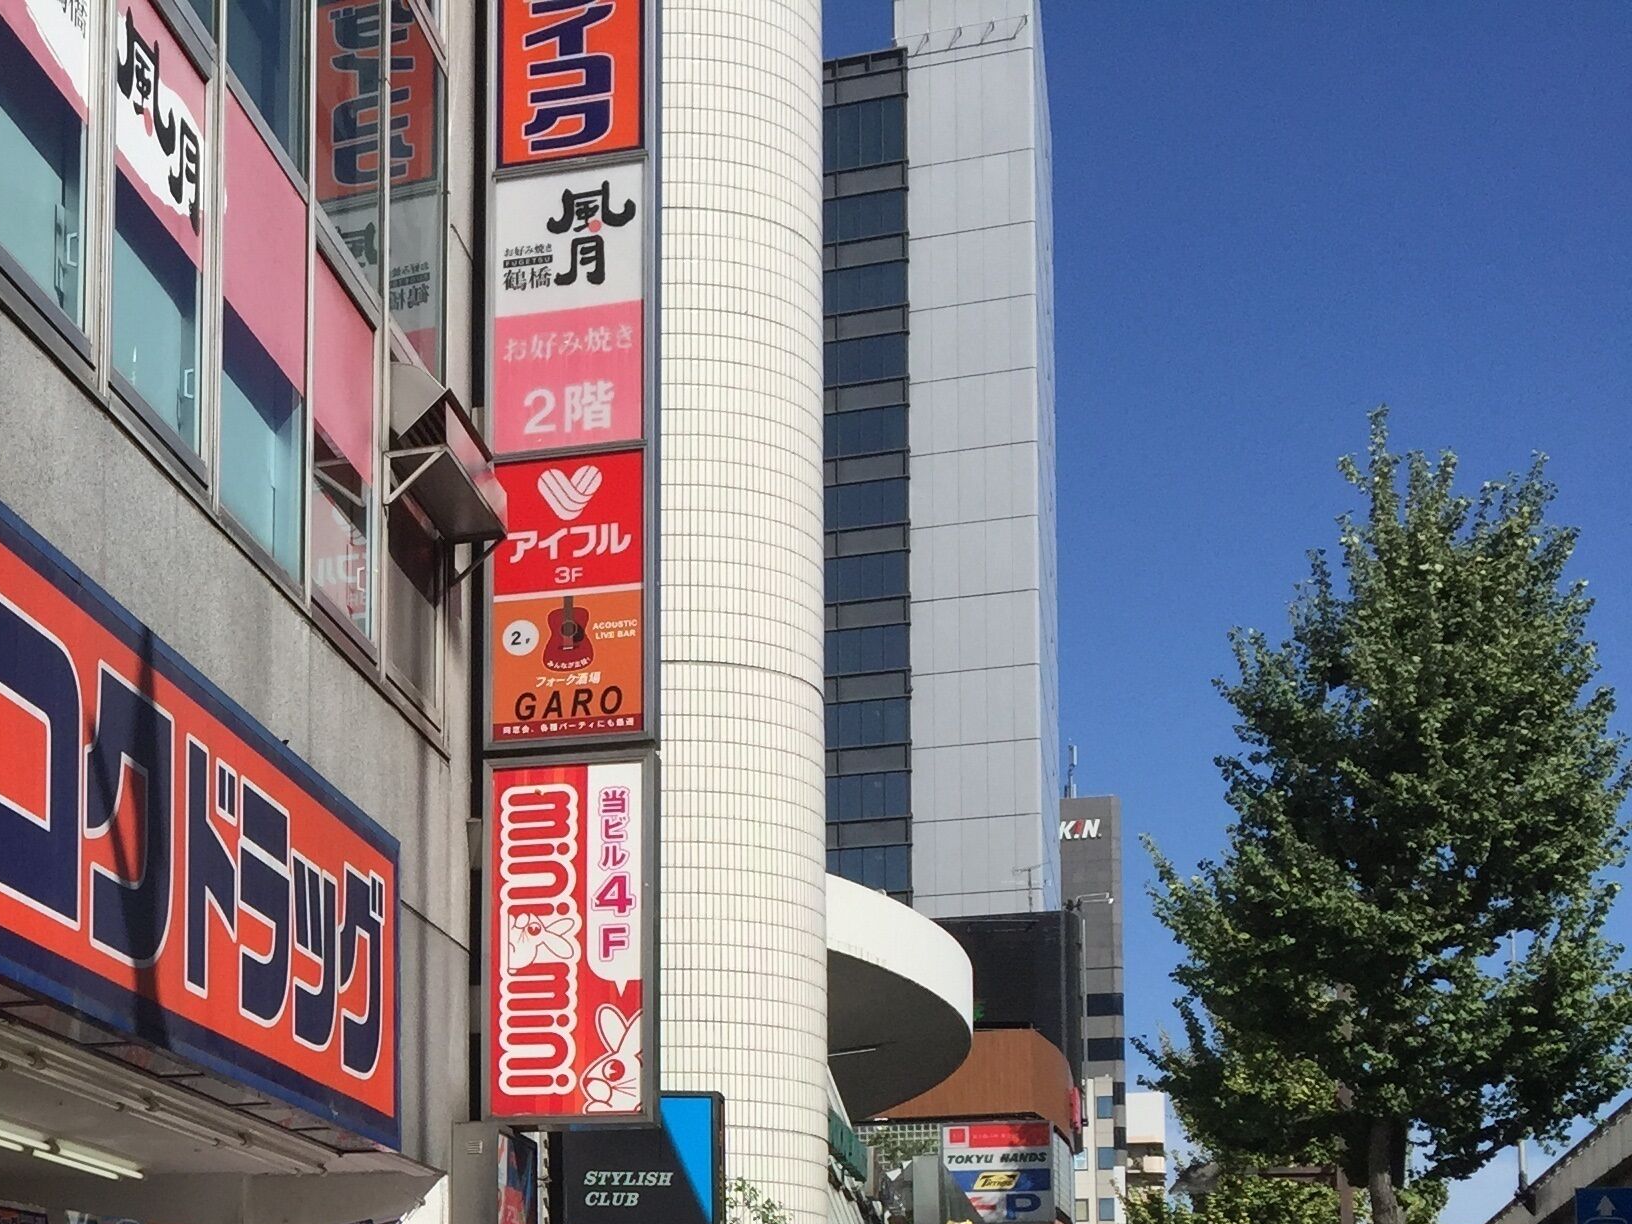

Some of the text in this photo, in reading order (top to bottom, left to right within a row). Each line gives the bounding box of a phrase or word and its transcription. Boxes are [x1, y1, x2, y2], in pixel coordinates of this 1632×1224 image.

[522, 0, 616, 154] イコク
[546, 180, 636, 286] 風月
[503, 267, 552, 291] 鶴橋
[503, 325, 633, 362] お好み焼き
[523, 380, 615, 434] 2階
[506, 523, 632, 564] アイフル
[554, 567, 583, 584] 3F
[617, 629, 636, 638] BAR
[515, 685, 623, 721] GARO
[948, 1151, 1048, 1164] TOKYU HANDS
[583, 1170, 674, 1186] STYLISH
[584, 1191, 640, 1207] CLUB
